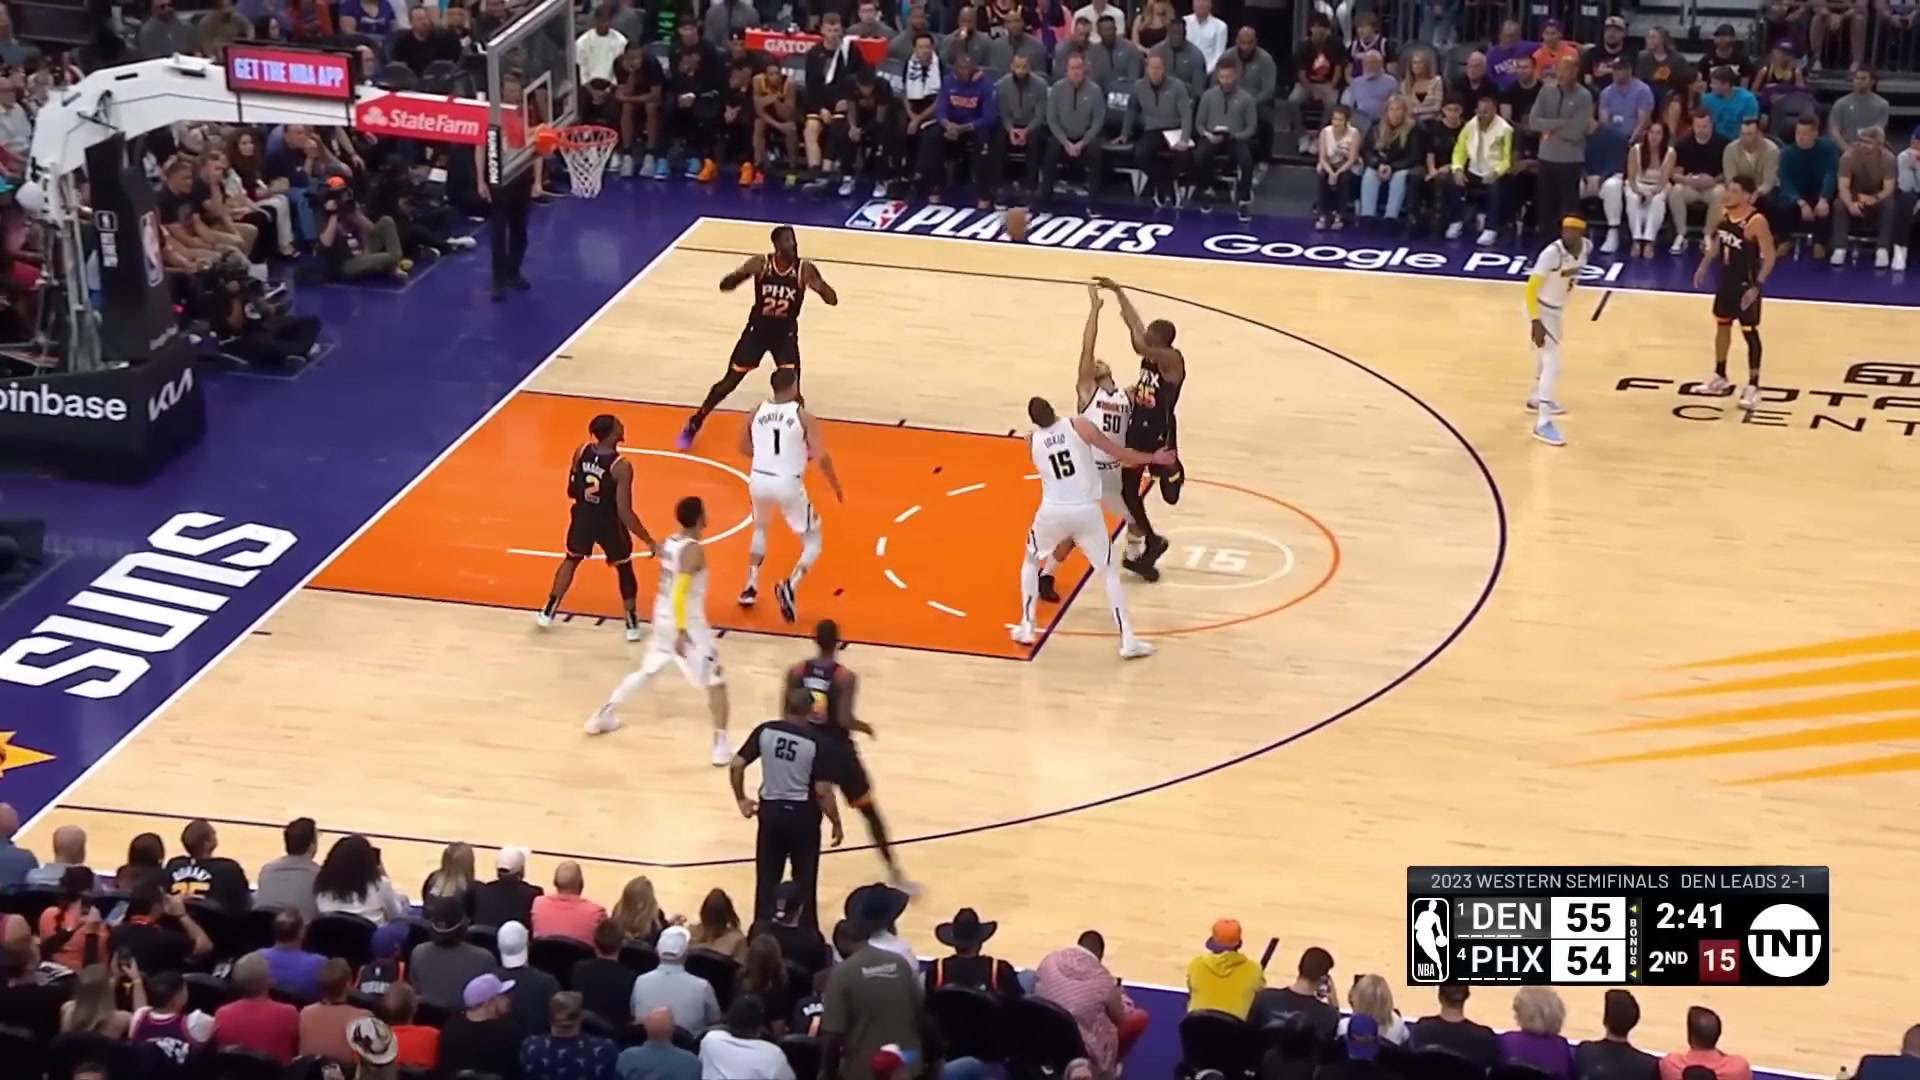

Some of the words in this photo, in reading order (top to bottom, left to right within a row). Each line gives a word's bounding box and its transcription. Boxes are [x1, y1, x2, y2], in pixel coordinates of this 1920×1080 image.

[234, 57, 260, 80] GET
[261, 61, 288, 83] THE
[288, 63, 317, 86] NBA
[318, 65, 344, 88] APP
[1202, 233, 1447, 270] Google
[1463, 252, 1624, 282] Piel
[762, 284, 797, 299] PHX
[762, 299, 791, 316] 22
[1103, 413, 1121, 434] 50
[773, 428, 781, 456] 1
[1048, 449, 1076, 480] 15
[584, 474, 601, 505] 2
[1182, 545, 1253, 573] 15
[0, 512, 298, 700] SUNS
[775, 736, 799, 763] 25
